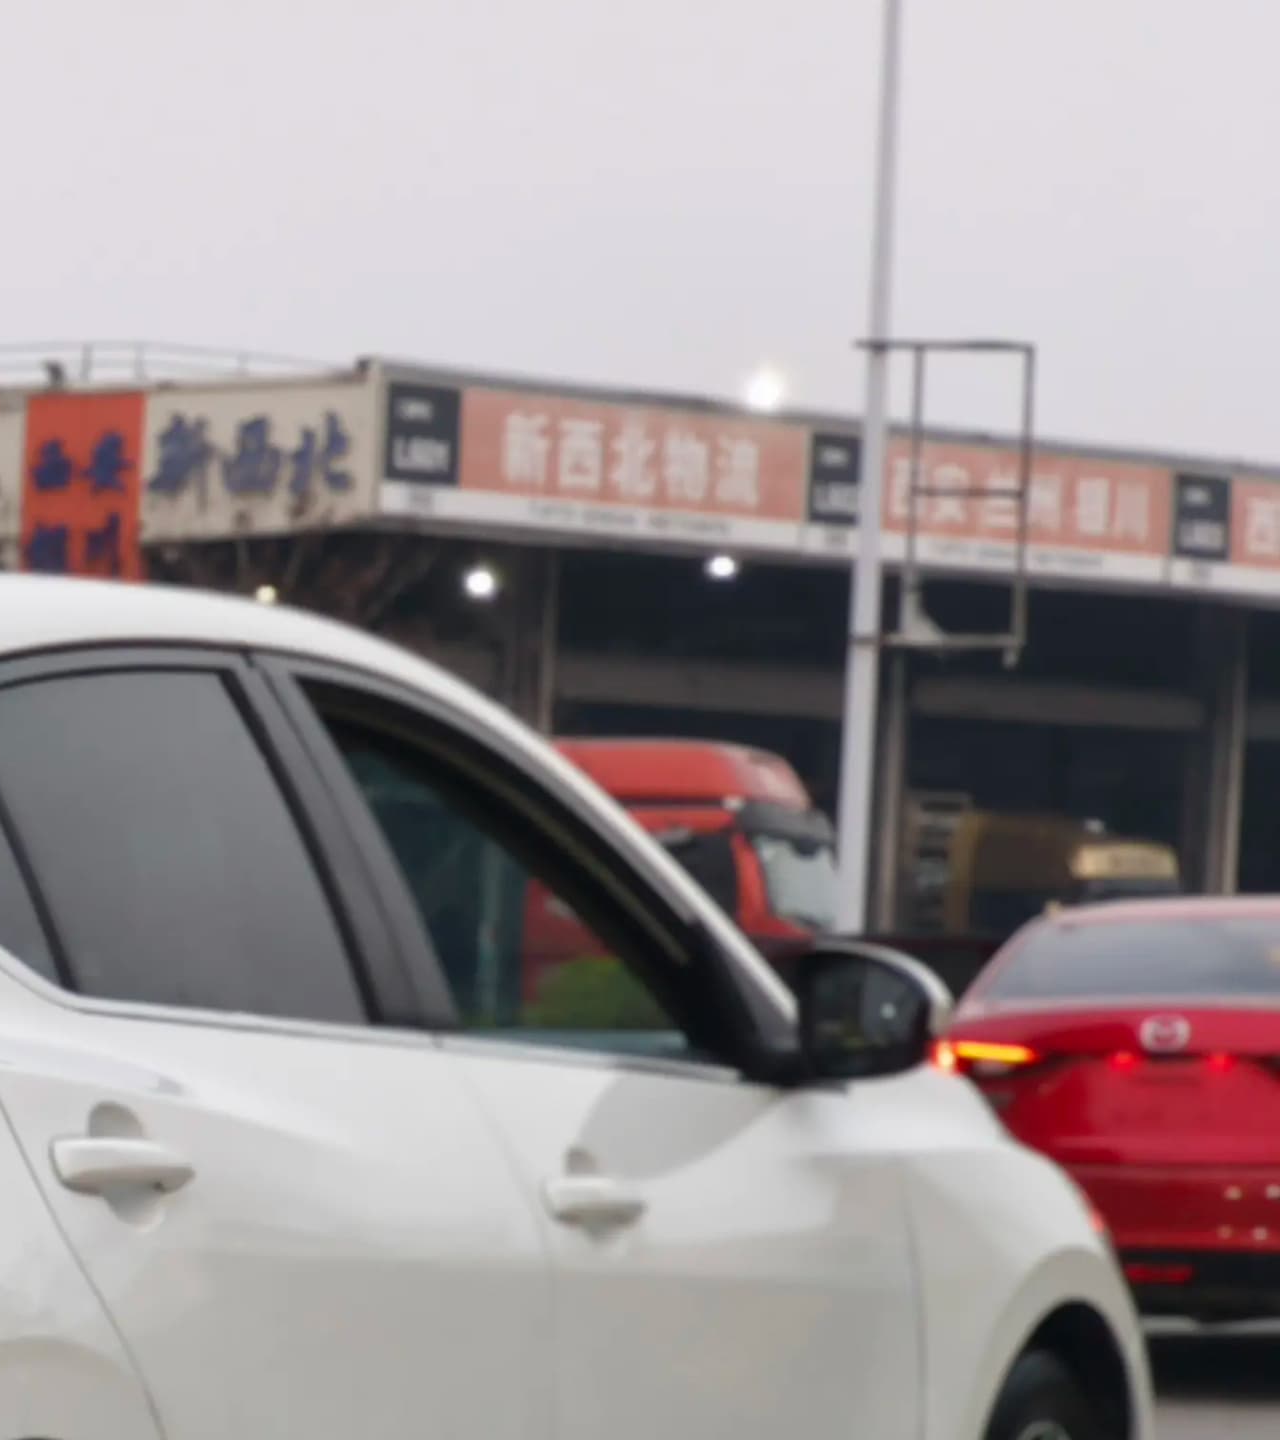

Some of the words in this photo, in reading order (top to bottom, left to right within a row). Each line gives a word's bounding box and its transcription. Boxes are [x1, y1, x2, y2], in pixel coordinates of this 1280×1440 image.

[148, 410, 354, 500] 新西北
[500, 411, 764, 509] 新西北物流
